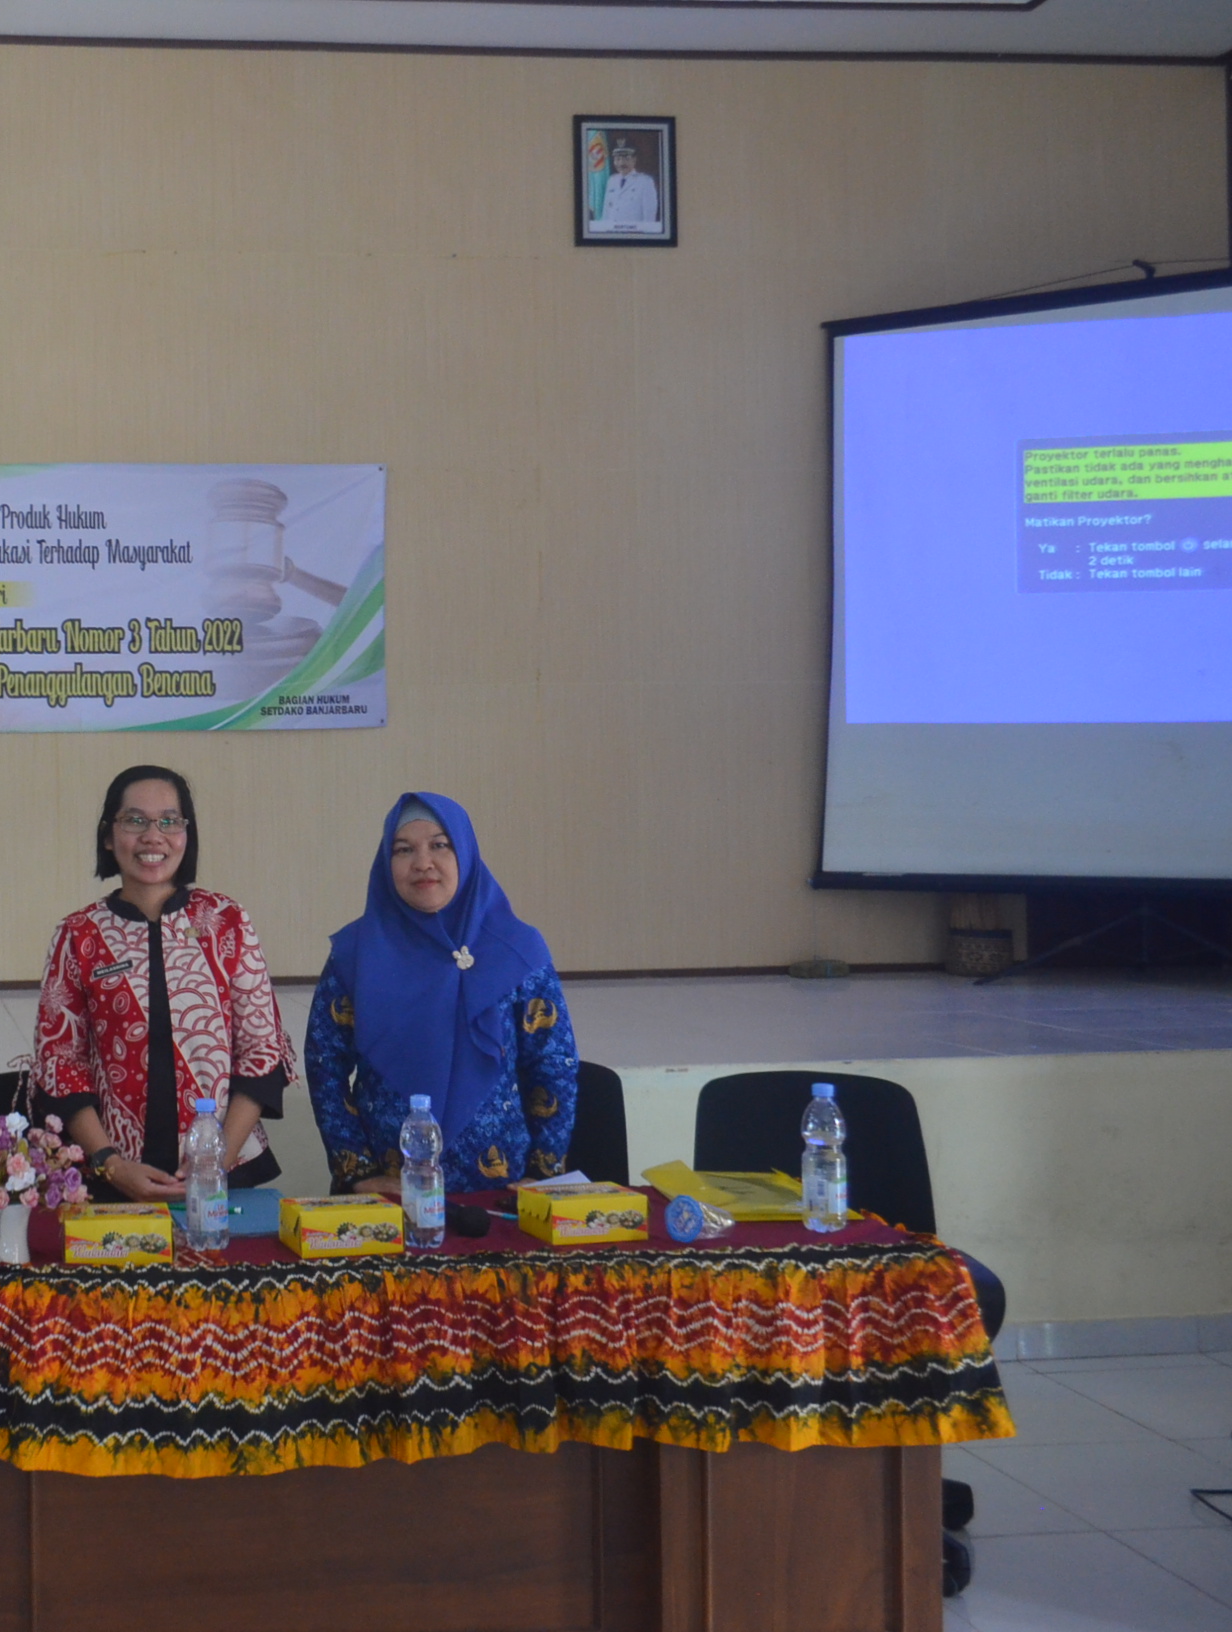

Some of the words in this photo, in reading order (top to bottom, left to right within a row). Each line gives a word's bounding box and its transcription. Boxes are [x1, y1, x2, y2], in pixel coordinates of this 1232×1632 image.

[1026, 451, 1089, 462] Proyektor
[1094, 448, 1135, 459] terlalu
[1139, 447, 1181, 458] panas.
[1026, 464, 1080, 474] Pastikan
[1085, 462, 1116, 473] tidak
[1120, 462, 1144, 472] ada
[1149, 461, 1180, 472] yang
[1026, 477, 1079, 488] ventilasi
[1082, 476, 1123, 486] udara,
[1128, 475, 1151, 484] dan
[1155, 472, 1218, 483] bersihkan
[1026, 491, 1058, 502] ganti
[1062, 490, 1093, 500] filter
[1097, 489, 1139, 499] udara.
[0, 503, 52, 530] Produk
[56, 503, 107, 530] Hukum
[1025, 517, 1075, 527] Matikan
[1078, 514, 1152, 528] Proyektor?
[1038, 543, 1056, 553] Ya
[1089, 542, 1128, 553] Tekan
[1132, 541, 1176, 551] tombol
[36, 538, 100, 570] Terhadap
[105, 538, 193, 572] Masyarakat
[1089, 556, 1097, 566] 2
[1100, 555, 1134, 566] detik
[1039, 569, 1073, 580] Tidak
[1089, 568, 1128, 579] Tekan
[1132, 567, 1176, 578] tombol
[1179, 567, 1202, 577] lain
[62, 618, 125, 654] Nomor
[128, 618, 142, 654] 3
[145, 617, 201, 654] Tahun
[202, 618, 243, 655] 2022
[138, 662, 216, 697] Bencana
[279, 695, 315, 705] BAGIAN
[317, 695, 350, 704] HUKUM
[260, 706, 304, 716] SETDAKO
[306, 705, 368, 715] BANJARBARU
